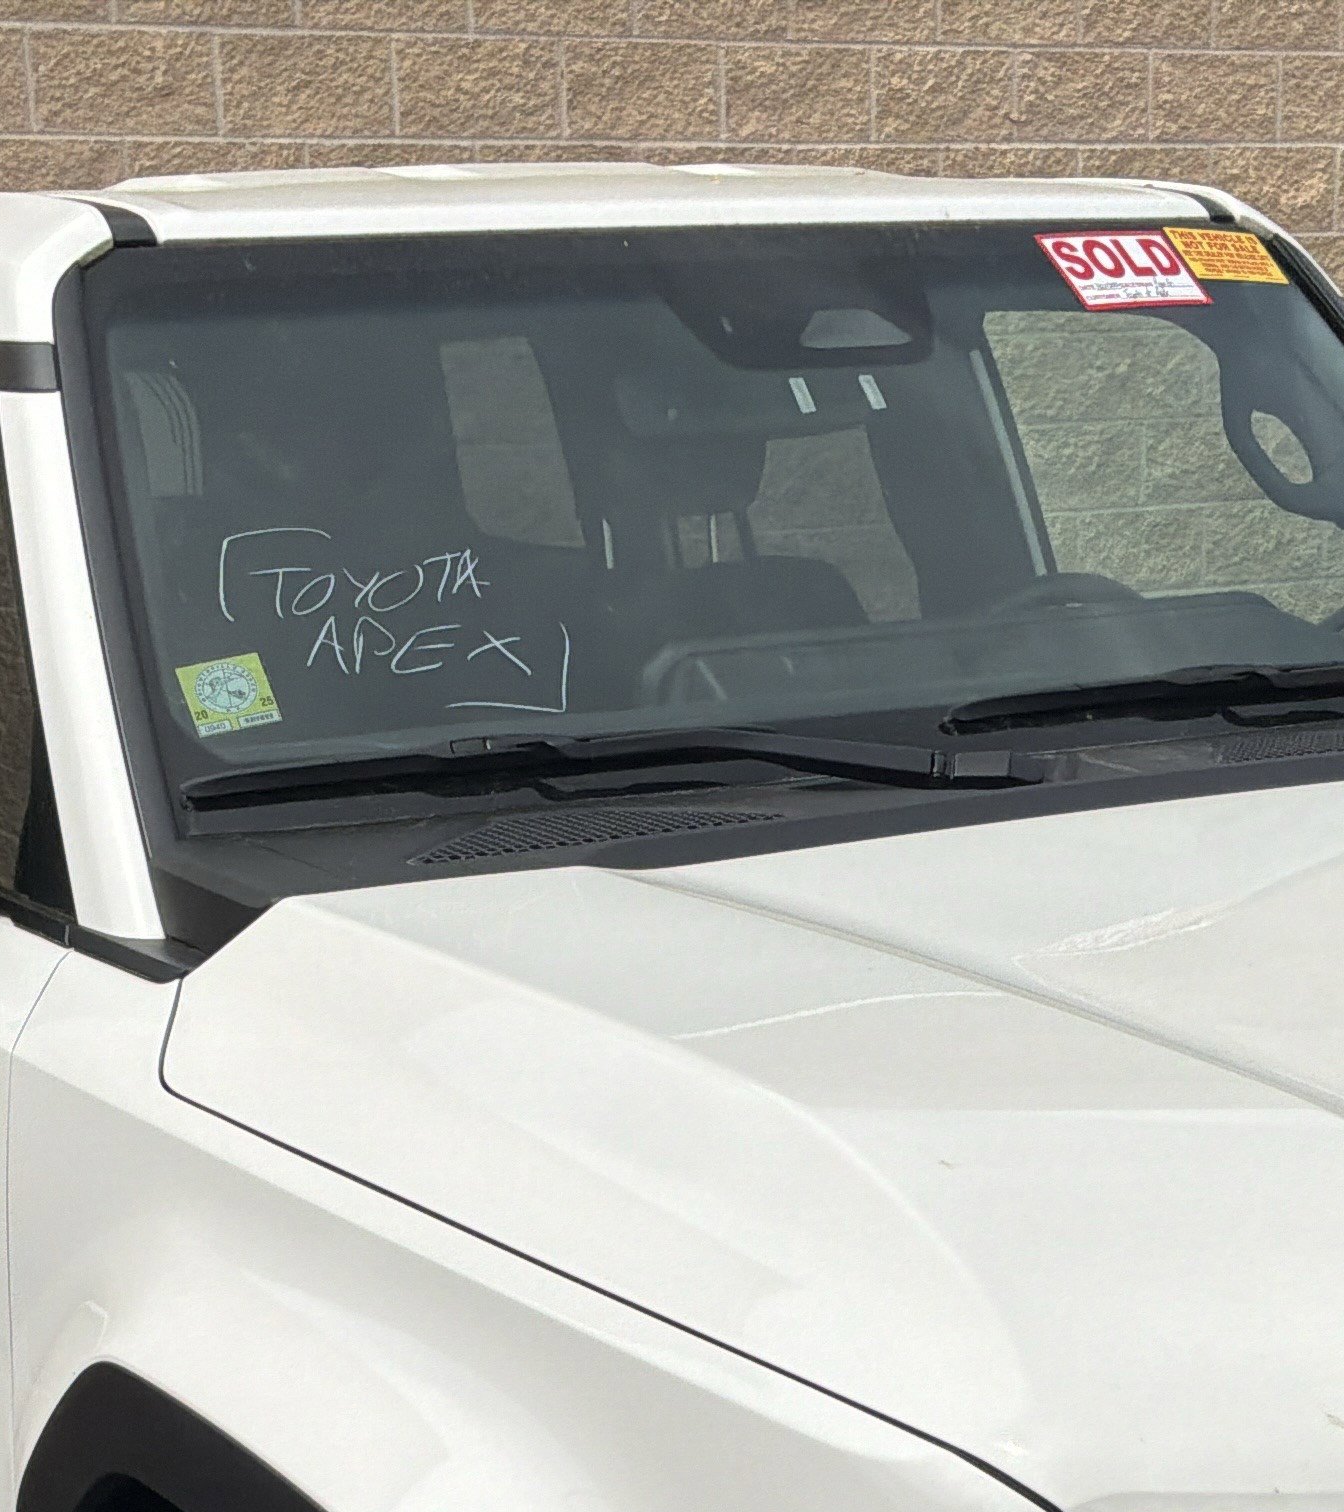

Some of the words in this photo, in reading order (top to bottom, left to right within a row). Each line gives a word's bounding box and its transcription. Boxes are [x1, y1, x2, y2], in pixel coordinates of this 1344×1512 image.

[1169, 230, 1197, 241] THIS
[1197, 232, 1245, 244] VEHICLE
[1181, 241, 1205, 250] NOT
[1206, 241, 1232, 251] FOR
[1231, 243, 1260, 254] SALE
[1051, 239, 1181, 280] SOLD
[249, 548, 490, 619] TOYOTA
[306, 616, 532, 676] APEX
[259, 695, 274, 707] 25
[194, 709, 208, 721] 20
